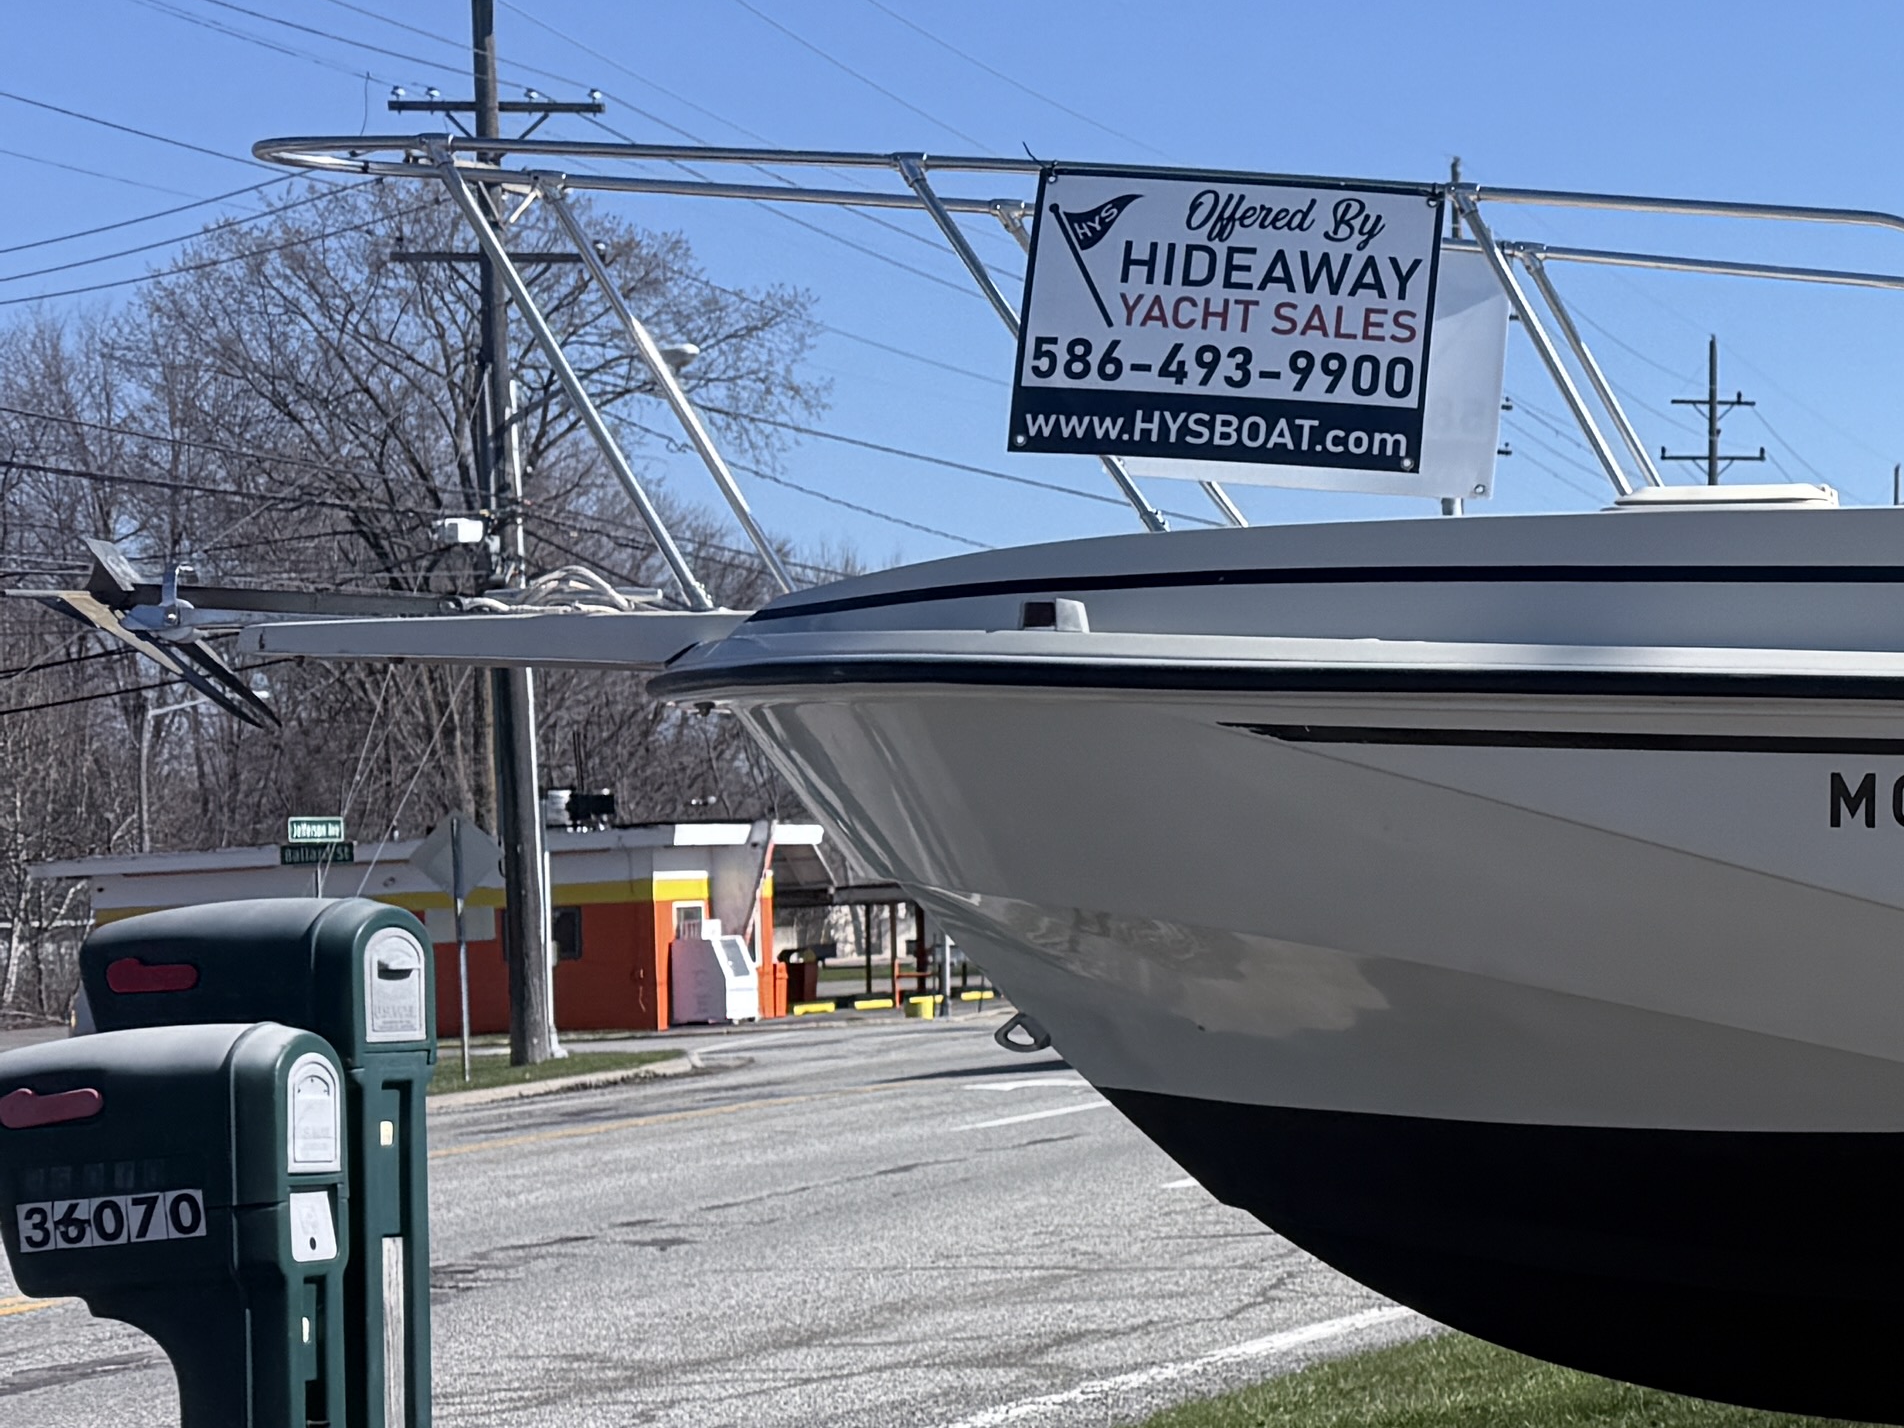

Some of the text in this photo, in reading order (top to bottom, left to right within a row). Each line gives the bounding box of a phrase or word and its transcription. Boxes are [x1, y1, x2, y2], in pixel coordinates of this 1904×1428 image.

[1075, 203, 1118, 241] HYS
[1185, 189, 1387, 252] Offered By
[1119, 240, 1423, 301] HIDEAWAY
[1119, 292, 1418, 344] YACHT SALES
[1030, 335, 1415, 400] 586-493-9900
[1025, 407, 1408, 458] www.HYSBOAT.com
[293, 822, 326, 838] Jefferson
[336, 846, 350, 861] St
[24, 1193, 202, 1249] 36070
